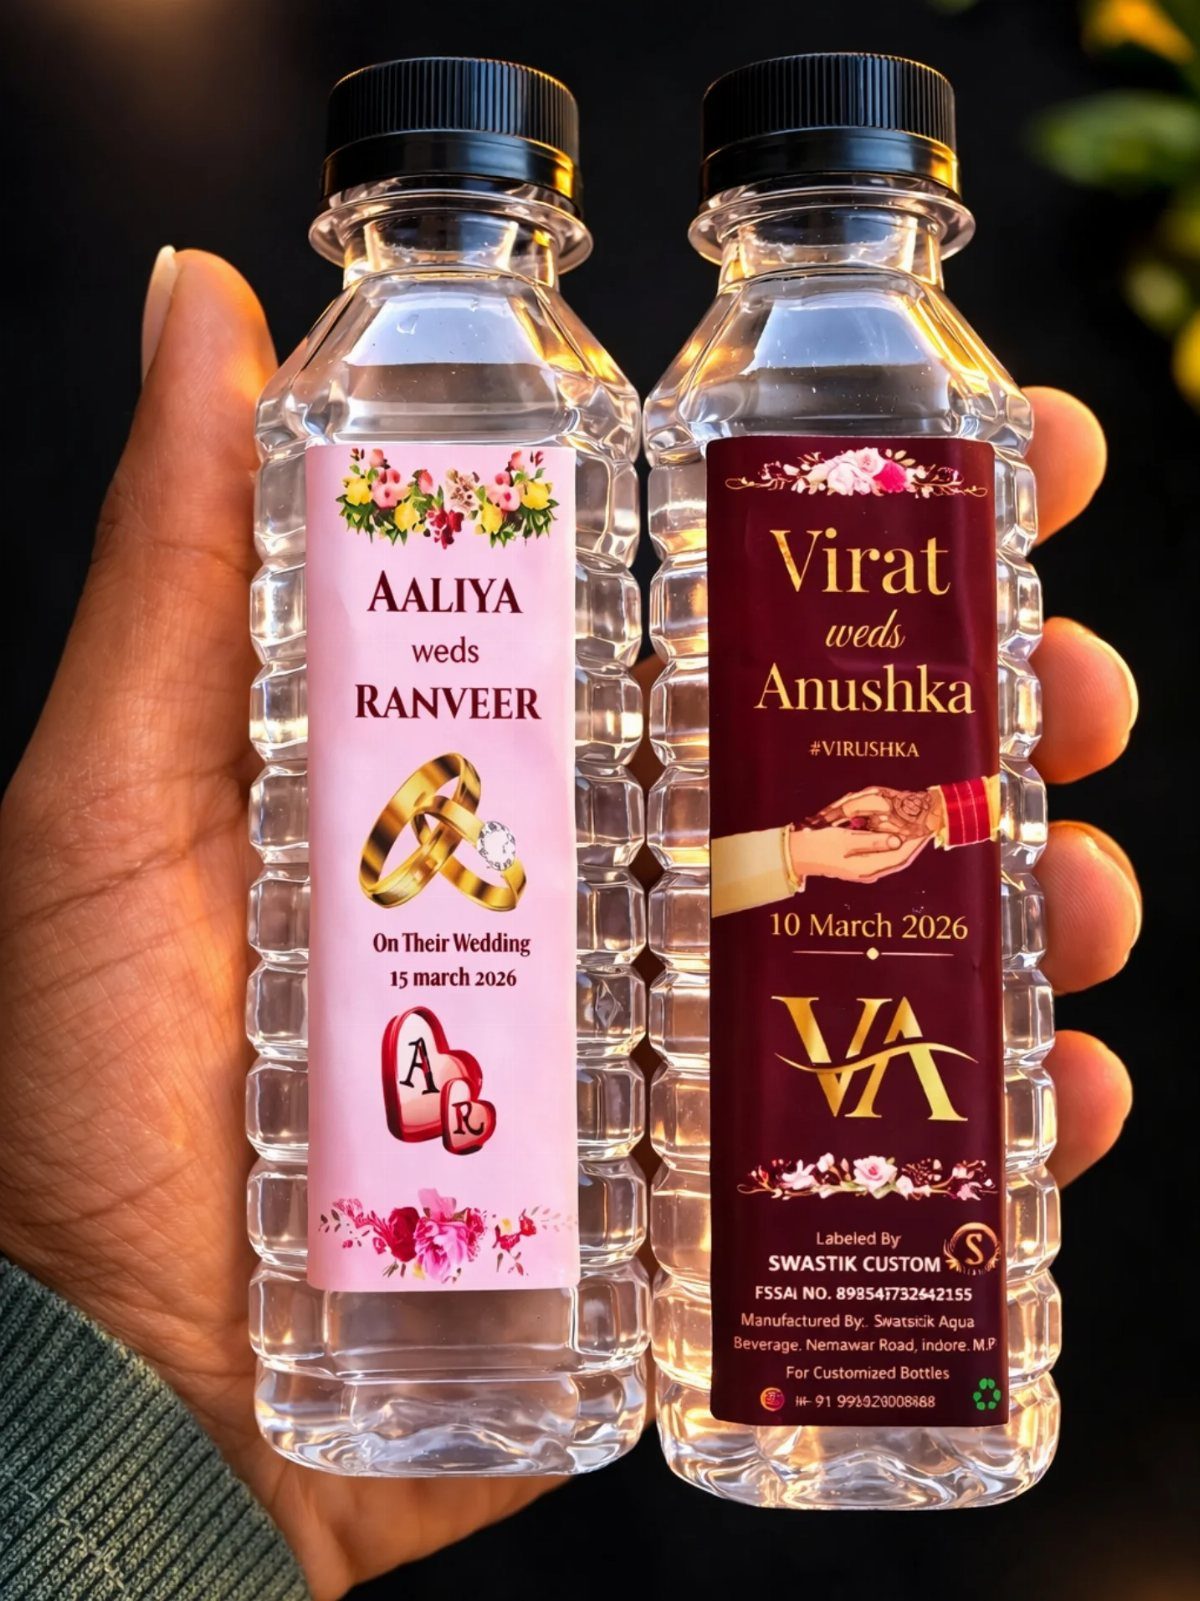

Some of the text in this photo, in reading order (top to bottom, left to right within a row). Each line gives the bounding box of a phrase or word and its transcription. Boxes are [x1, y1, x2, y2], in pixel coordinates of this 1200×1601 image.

[769, 527, 951, 596] Virat
[367, 570, 523, 614] AALIYA
[825, 609, 905, 649] weds
[412, 636, 479, 663] weds
[754, 662, 976, 714] Anushka
[355, 684, 542, 720] RANVEER
[810, 740, 920, 758] #VIRUSHKA
[770, 912, 969, 940] 10 March 2026
[373, 933, 531, 957] On Their Wedding
[390, 967, 517, 989] 15 march 2026
[399, 1037, 440, 1095] A
[771, 996, 979, 1122] VA
[451, 1100, 484, 1135] R
[816, 1231, 901, 1249] Labeled By
[768, 1255, 941, 1273] SWASTIK CUSTOM
[802, 1286, 832, 1301] NO.
[741, 1312, 840, 1328] Manufactured
[938, 1315, 975, 1332] Aqua
[806, 1339, 875, 1352] Nemawar
[879, 1338, 918, 1354] Road,
[786, 1366, 950, 1381] For Customized Bottles
